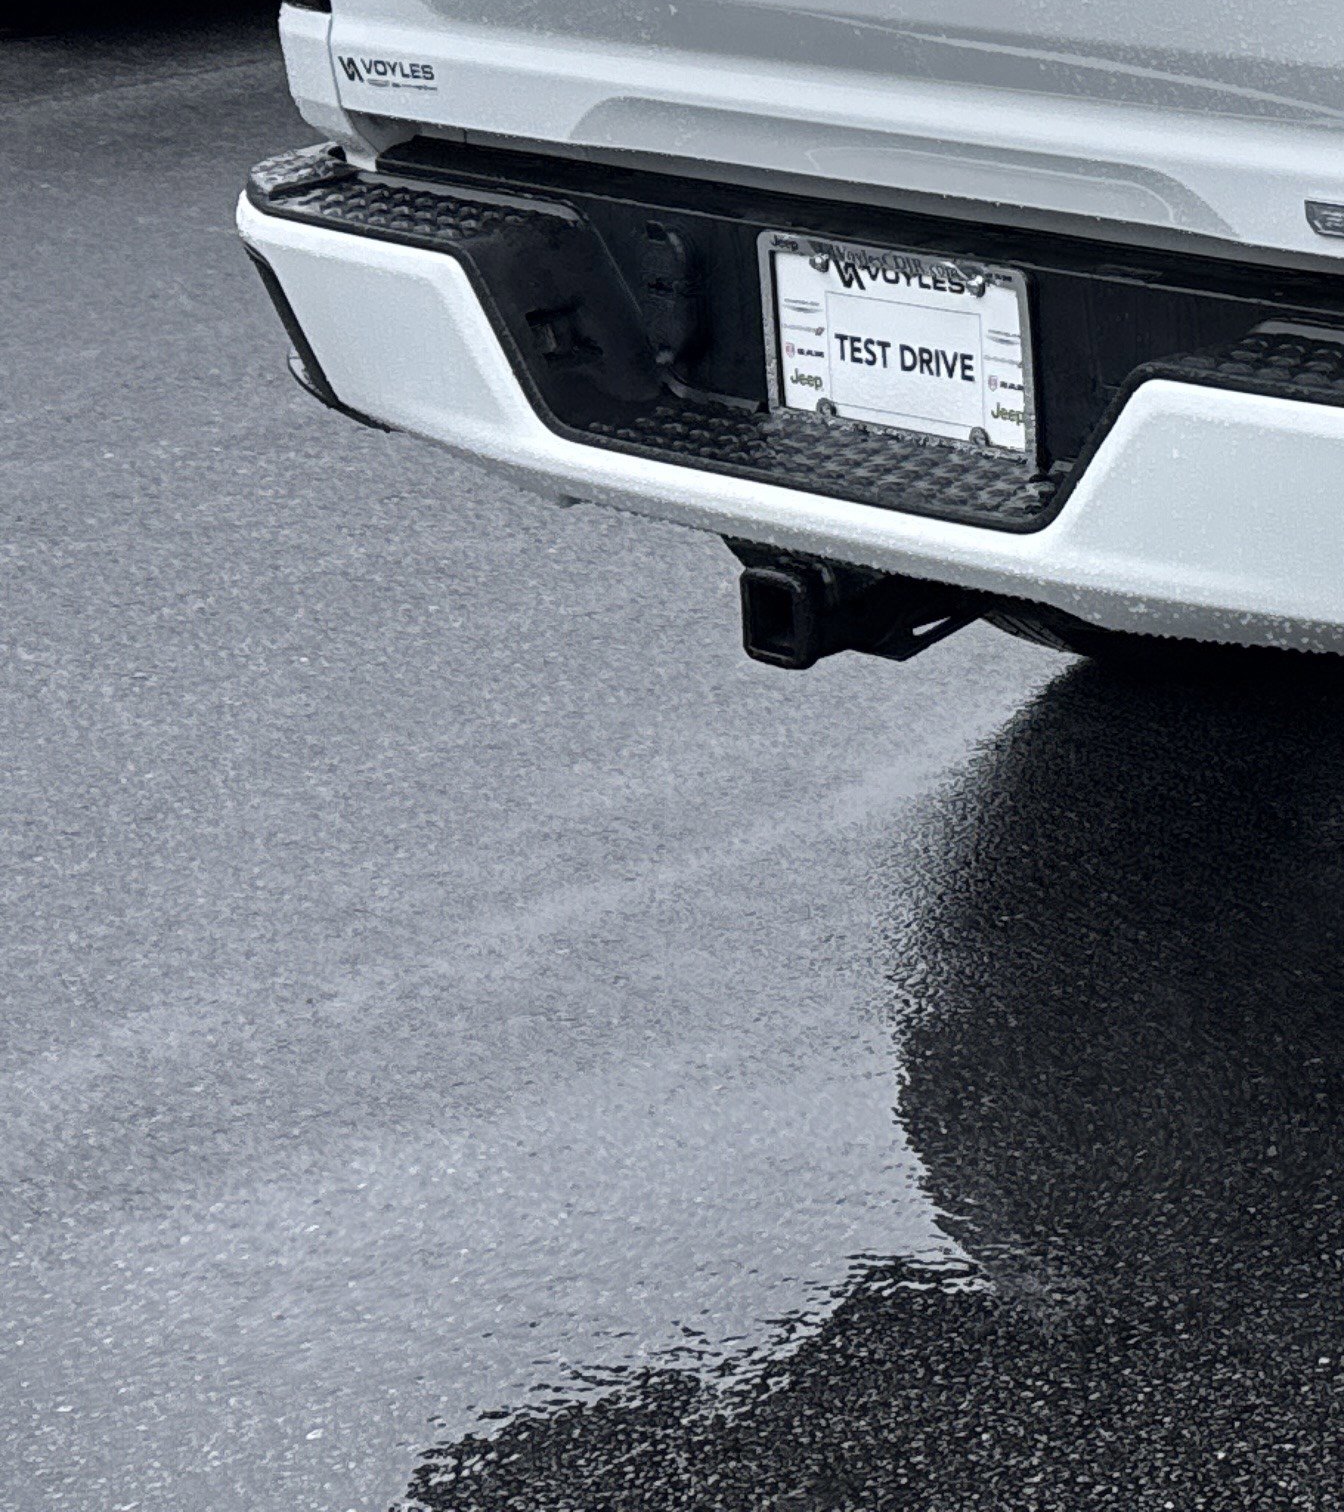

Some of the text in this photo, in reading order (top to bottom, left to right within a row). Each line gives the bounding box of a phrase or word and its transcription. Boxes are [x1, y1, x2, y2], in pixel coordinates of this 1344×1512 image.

[359, 57, 436, 81] VOYLES
[834, 333, 976, 382] TEST DRIVE
[790, 368, 824, 391] Jeep
